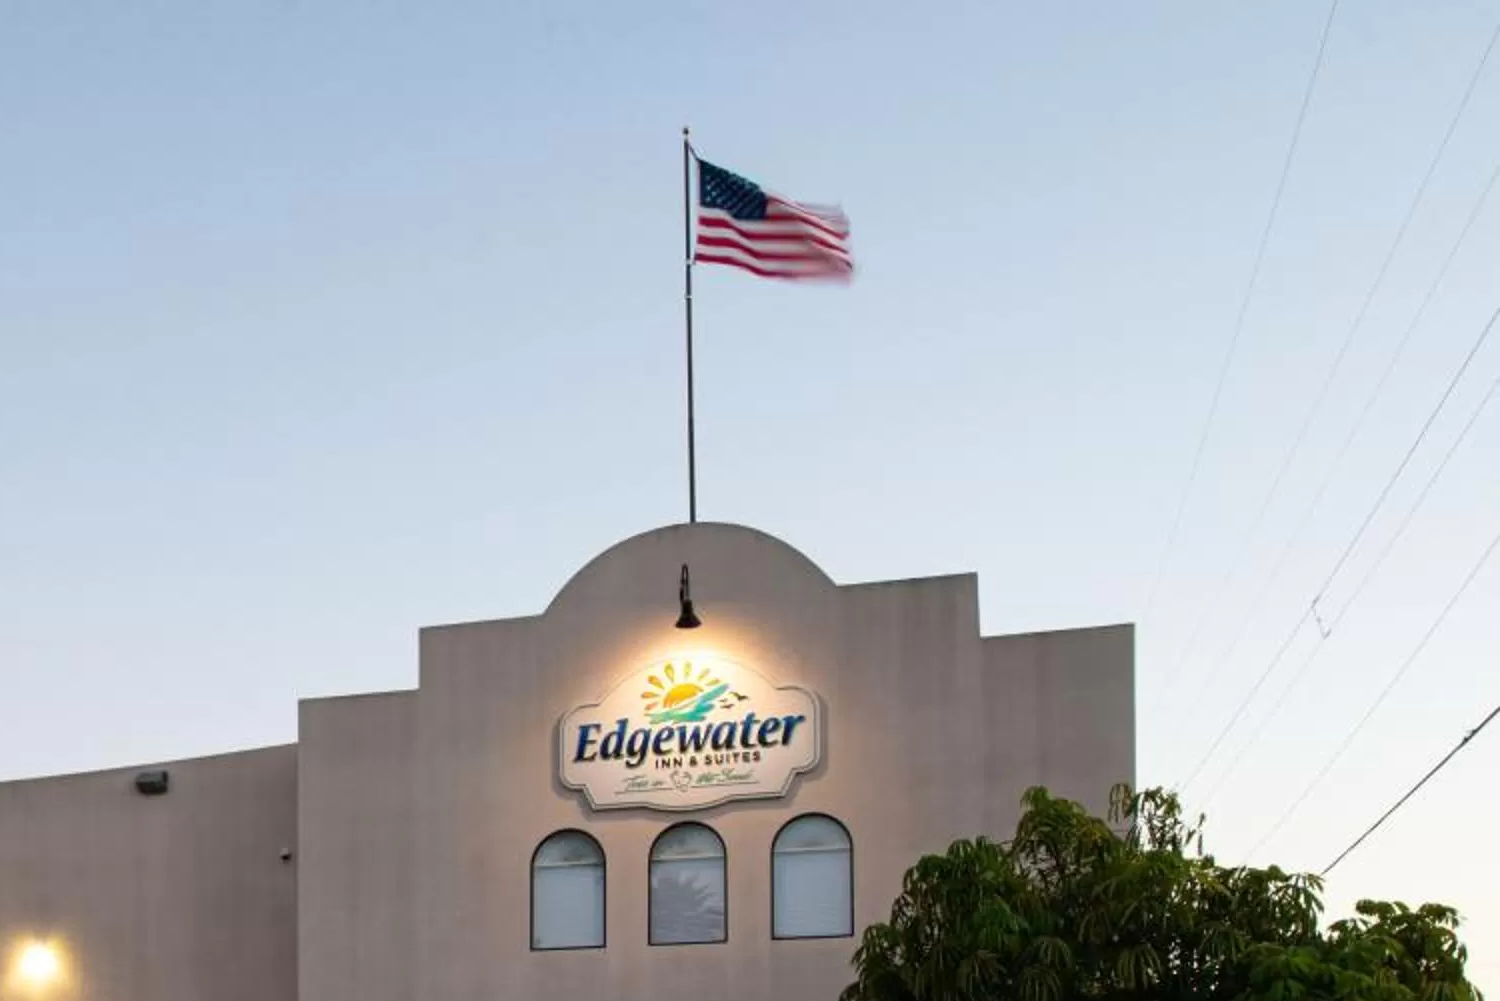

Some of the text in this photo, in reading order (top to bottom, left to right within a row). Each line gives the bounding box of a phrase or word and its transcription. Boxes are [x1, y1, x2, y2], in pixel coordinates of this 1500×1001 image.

[573, 712, 806, 769] Edgewater
[655, 750, 762, 769] INN & SUITES
